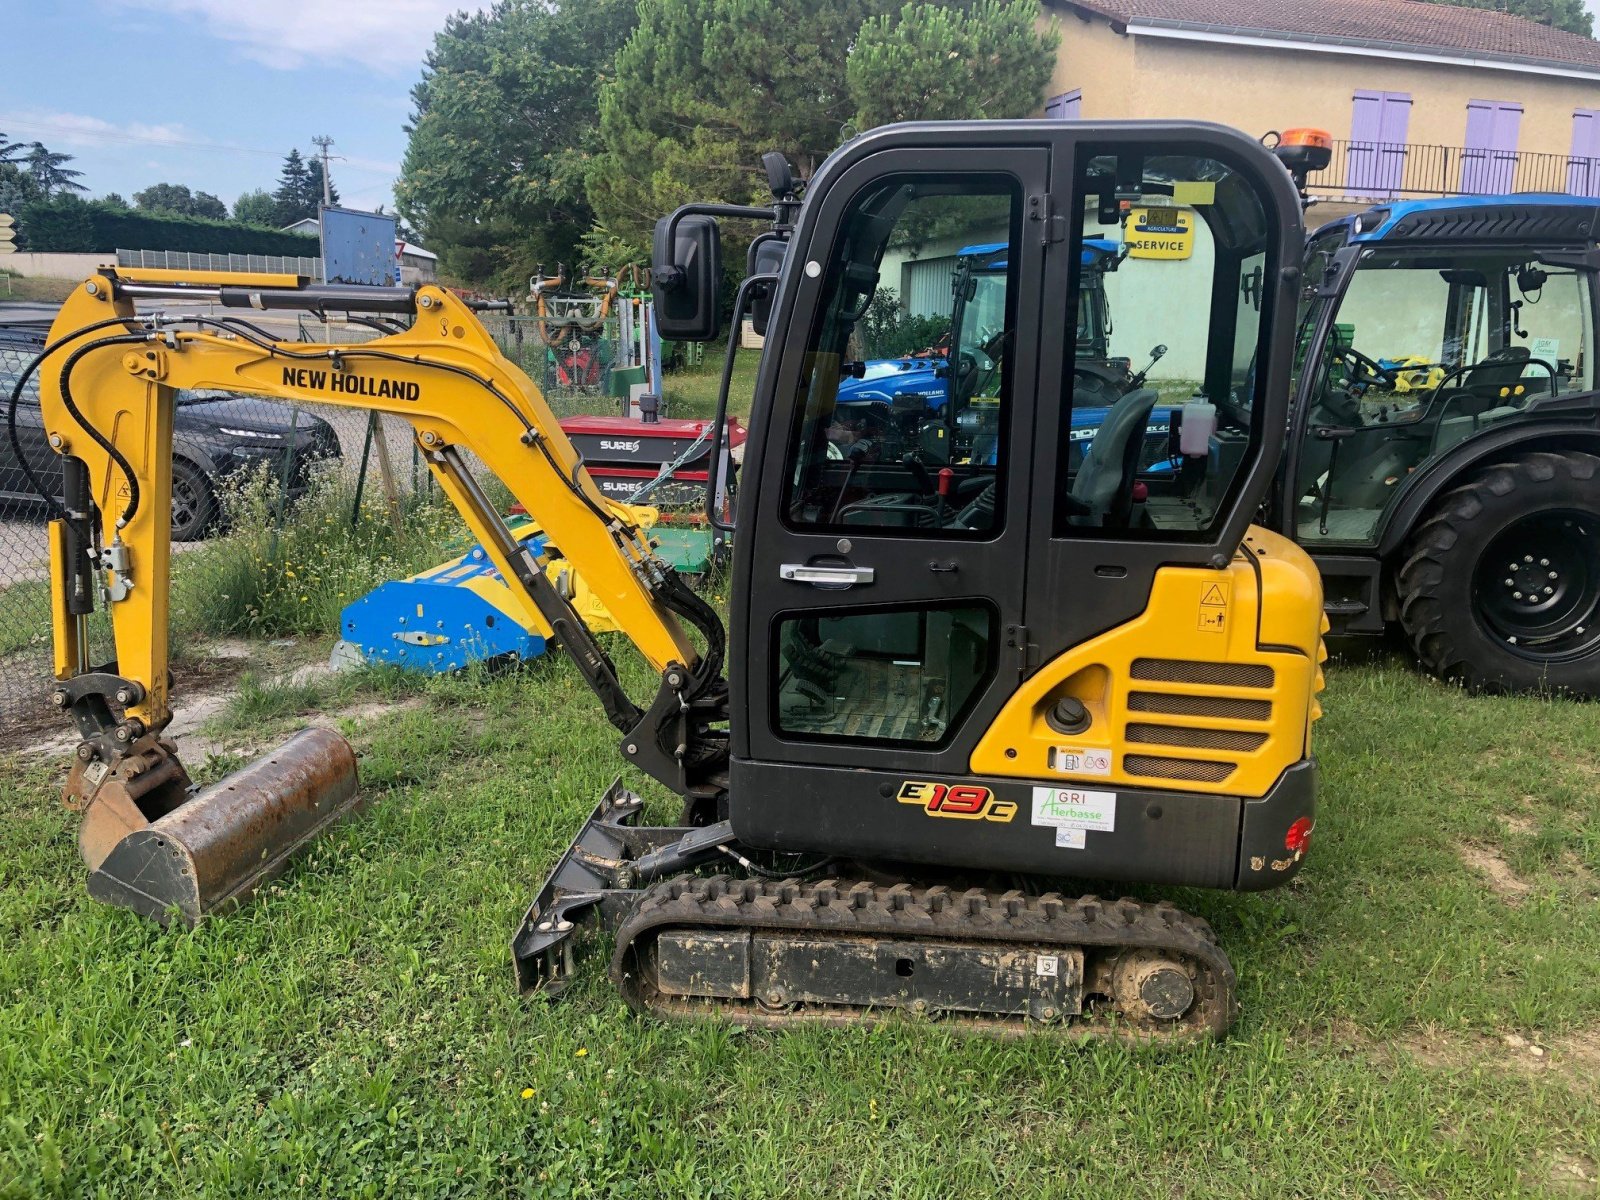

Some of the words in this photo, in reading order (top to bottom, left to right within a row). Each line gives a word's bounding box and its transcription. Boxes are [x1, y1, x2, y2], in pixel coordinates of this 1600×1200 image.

[1136, 241, 1184, 251] SERVICE
[283, 367, 326, 390] NEW
[331, 373, 420, 401] HOLLAND
[899, 784, 1014, 818] E19C
[1051, 807, 1102, 819] Herbasse
